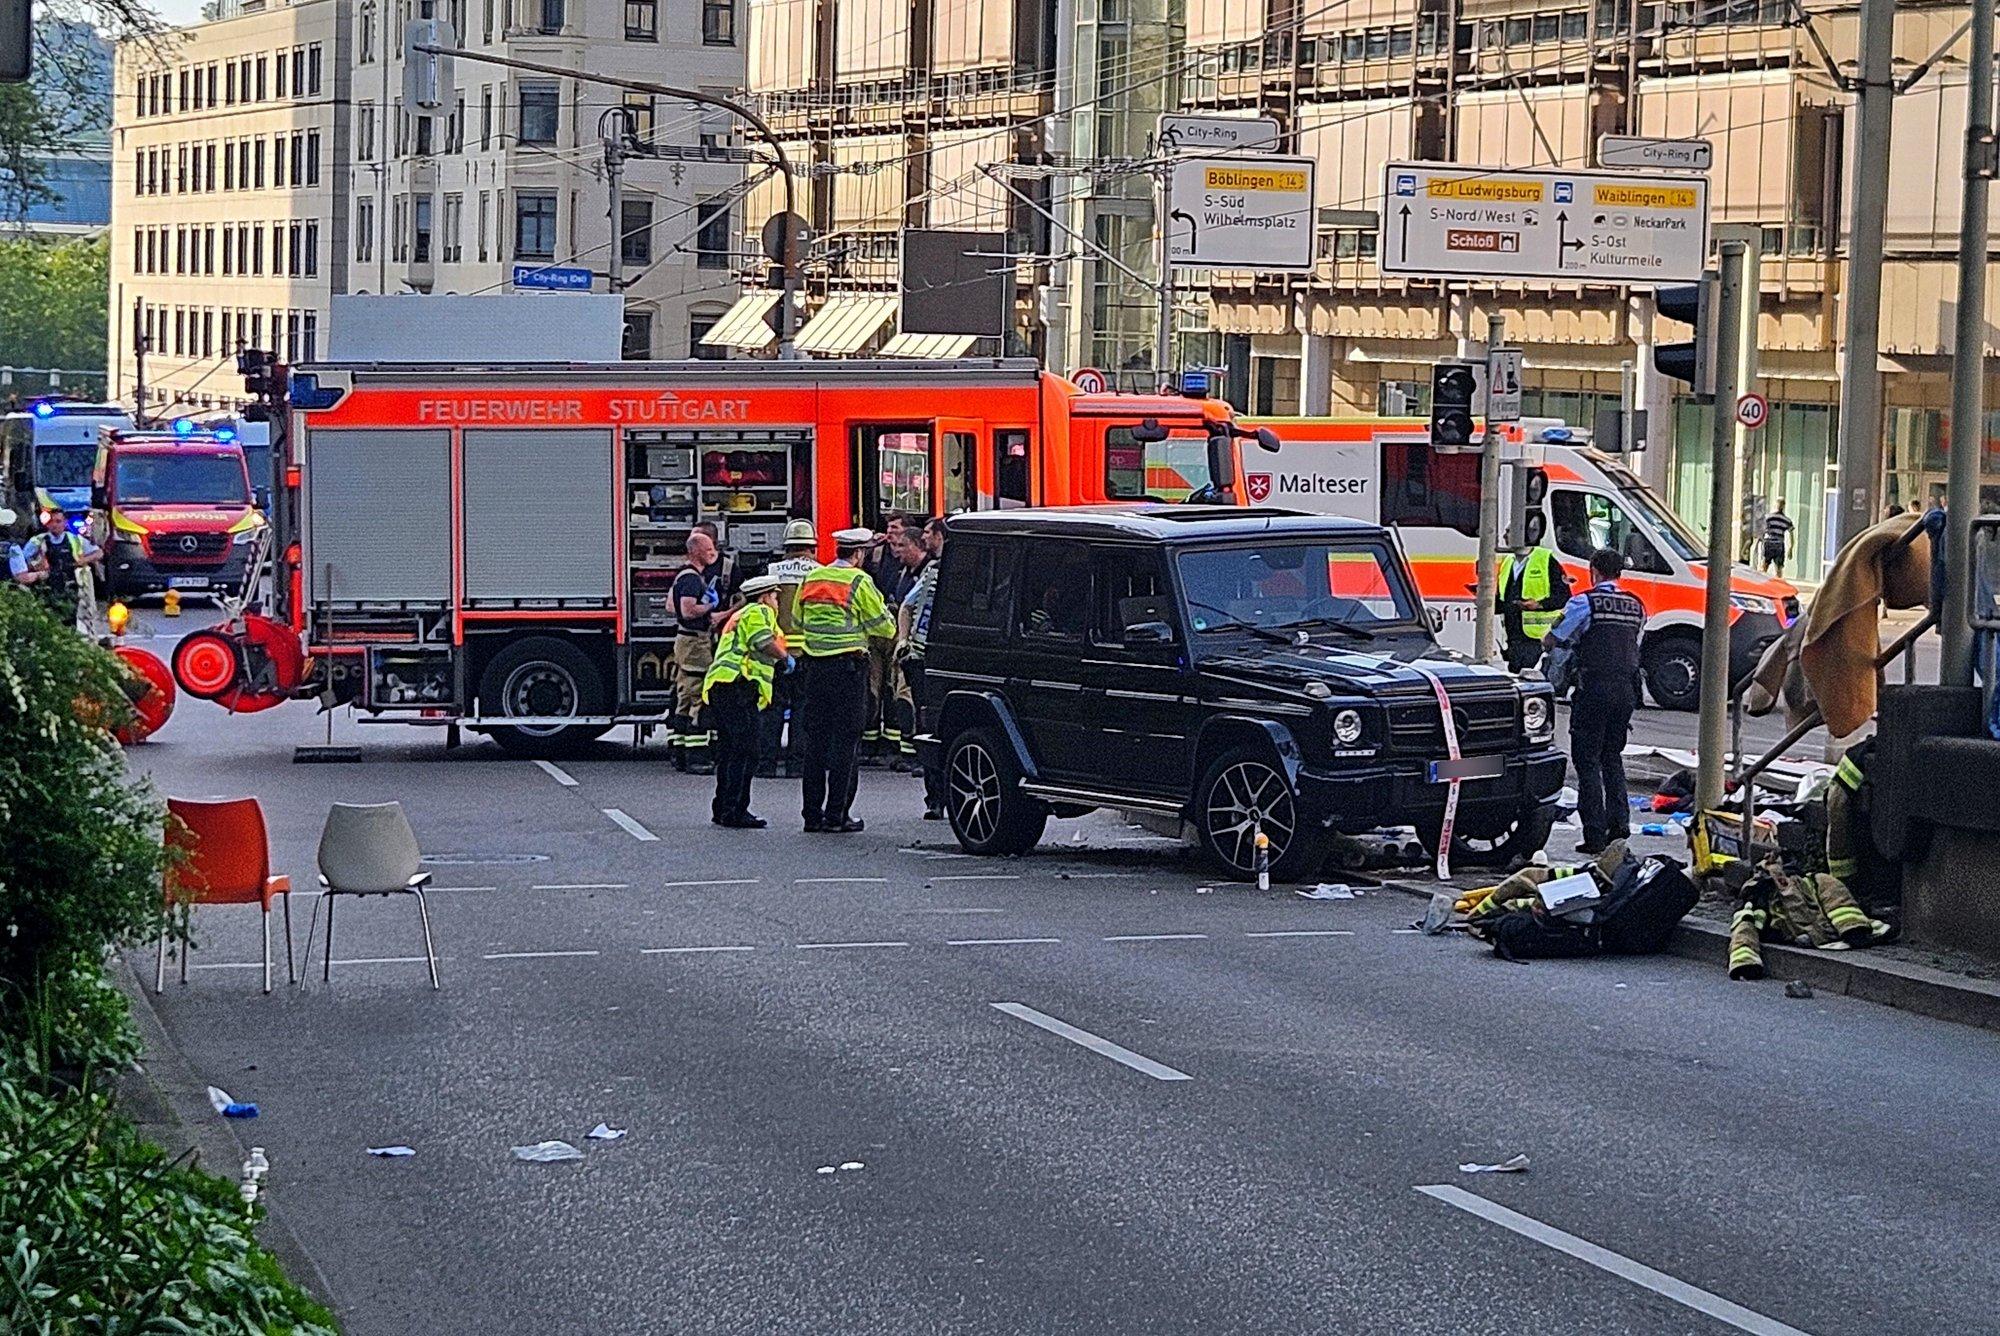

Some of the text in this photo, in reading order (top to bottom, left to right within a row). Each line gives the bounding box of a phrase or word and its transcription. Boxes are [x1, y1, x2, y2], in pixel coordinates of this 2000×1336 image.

[1187, 126, 1238, 141] City-Ring
[1642, 148, 1690, 162] City-Ring
[1208, 171, 1297, 189] Böblingen 14
[1435, 182, 1541, 201] 27 Ludwigsburg
[1597, 189, 1687, 206] Waiblingen 14
[1204, 194, 1245, 208] S-Süd
[1204, 212, 1296, 230] Wilhelmsplatz
[1430, 207, 1516, 223] S-Nord/West
[1633, 216, 1686, 230] NeckarPark
[1450, 233, 1494, 247] Schloß
[1591, 235, 1627, 248] S-Ost
[1170, 246, 1181, 255] 00
[1590, 252, 1663, 267] Kulturmeile
[533, 273, 568, 285] City-Ring
[418, 394, 750, 421] FEUERWEHR STUTTGART
[1741, 402, 1761, 419] 40
[1279, 472, 1369, 494] Malteser
[142, 511, 229, 521] FEUERWEHR
[776, 561, 818, 572] STUTTGA
